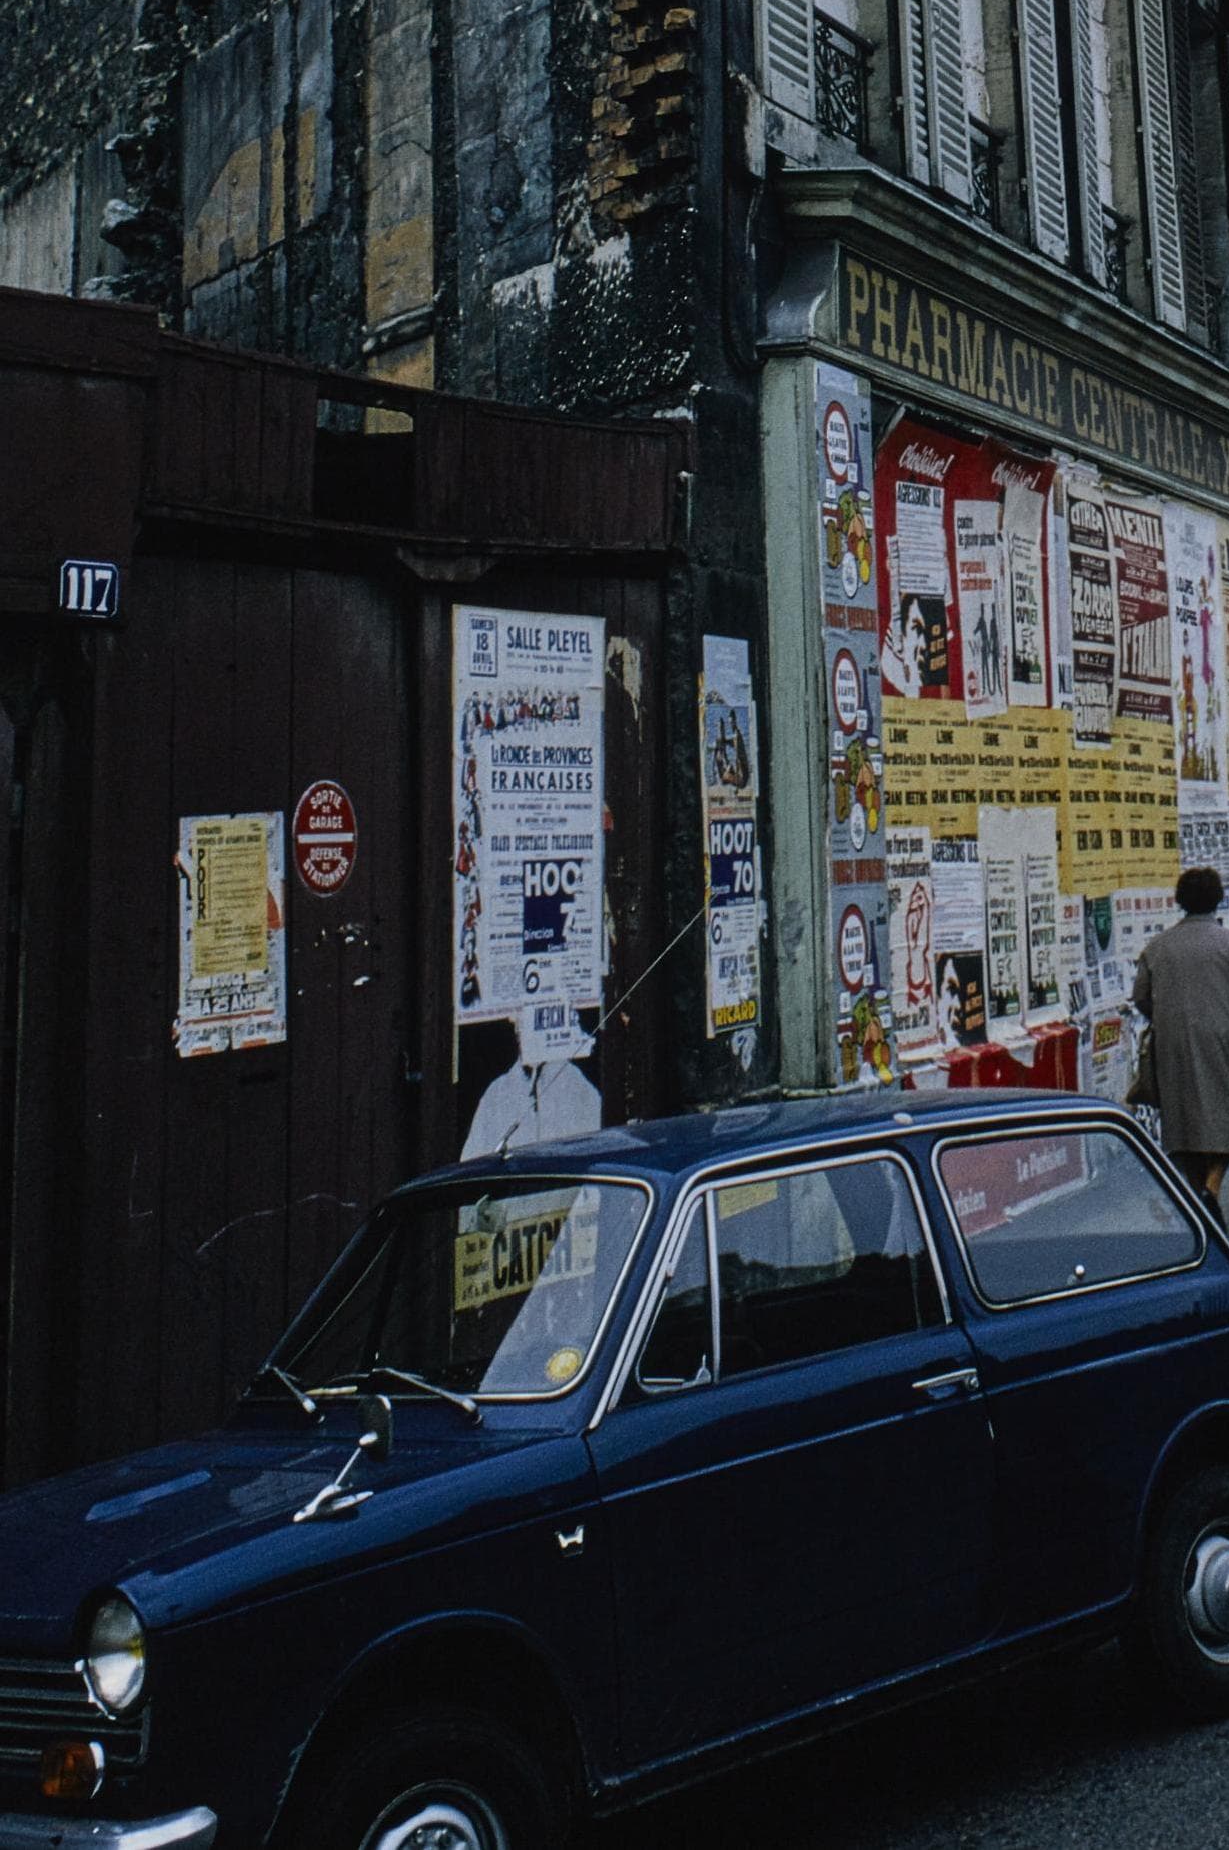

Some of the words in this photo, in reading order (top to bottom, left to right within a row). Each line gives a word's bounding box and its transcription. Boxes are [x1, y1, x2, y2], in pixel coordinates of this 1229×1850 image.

[846, 257, 1060, 428] PHARMACIE
[1068, 366, 1206, 486] CENTRALE
[66, 566, 113, 612] 117
[476, 633, 489, 651] 18
[507, 626, 542, 651] SALLE
[548, 630, 592, 654] PLEYEL
[500, 745, 531, 764] RONDE
[543, 746, 593, 766] PROVINCES
[491, 770, 593, 792] FRANÇAISES
[310, 789, 343, 811] SORTIE
[309, 815, 344, 830] GARAGE
[710, 821, 753, 856] HOOT
[931, 843, 965, 864] AGRESSIONS
[195, 849, 206, 920] POUR
[732, 859, 755, 894] 70
[711, 912, 723, 946] 6
[523, 958, 541, 994] 6
[714, 999, 757, 1028] RICARD
[492, 1218, 572, 1290] CATCH
